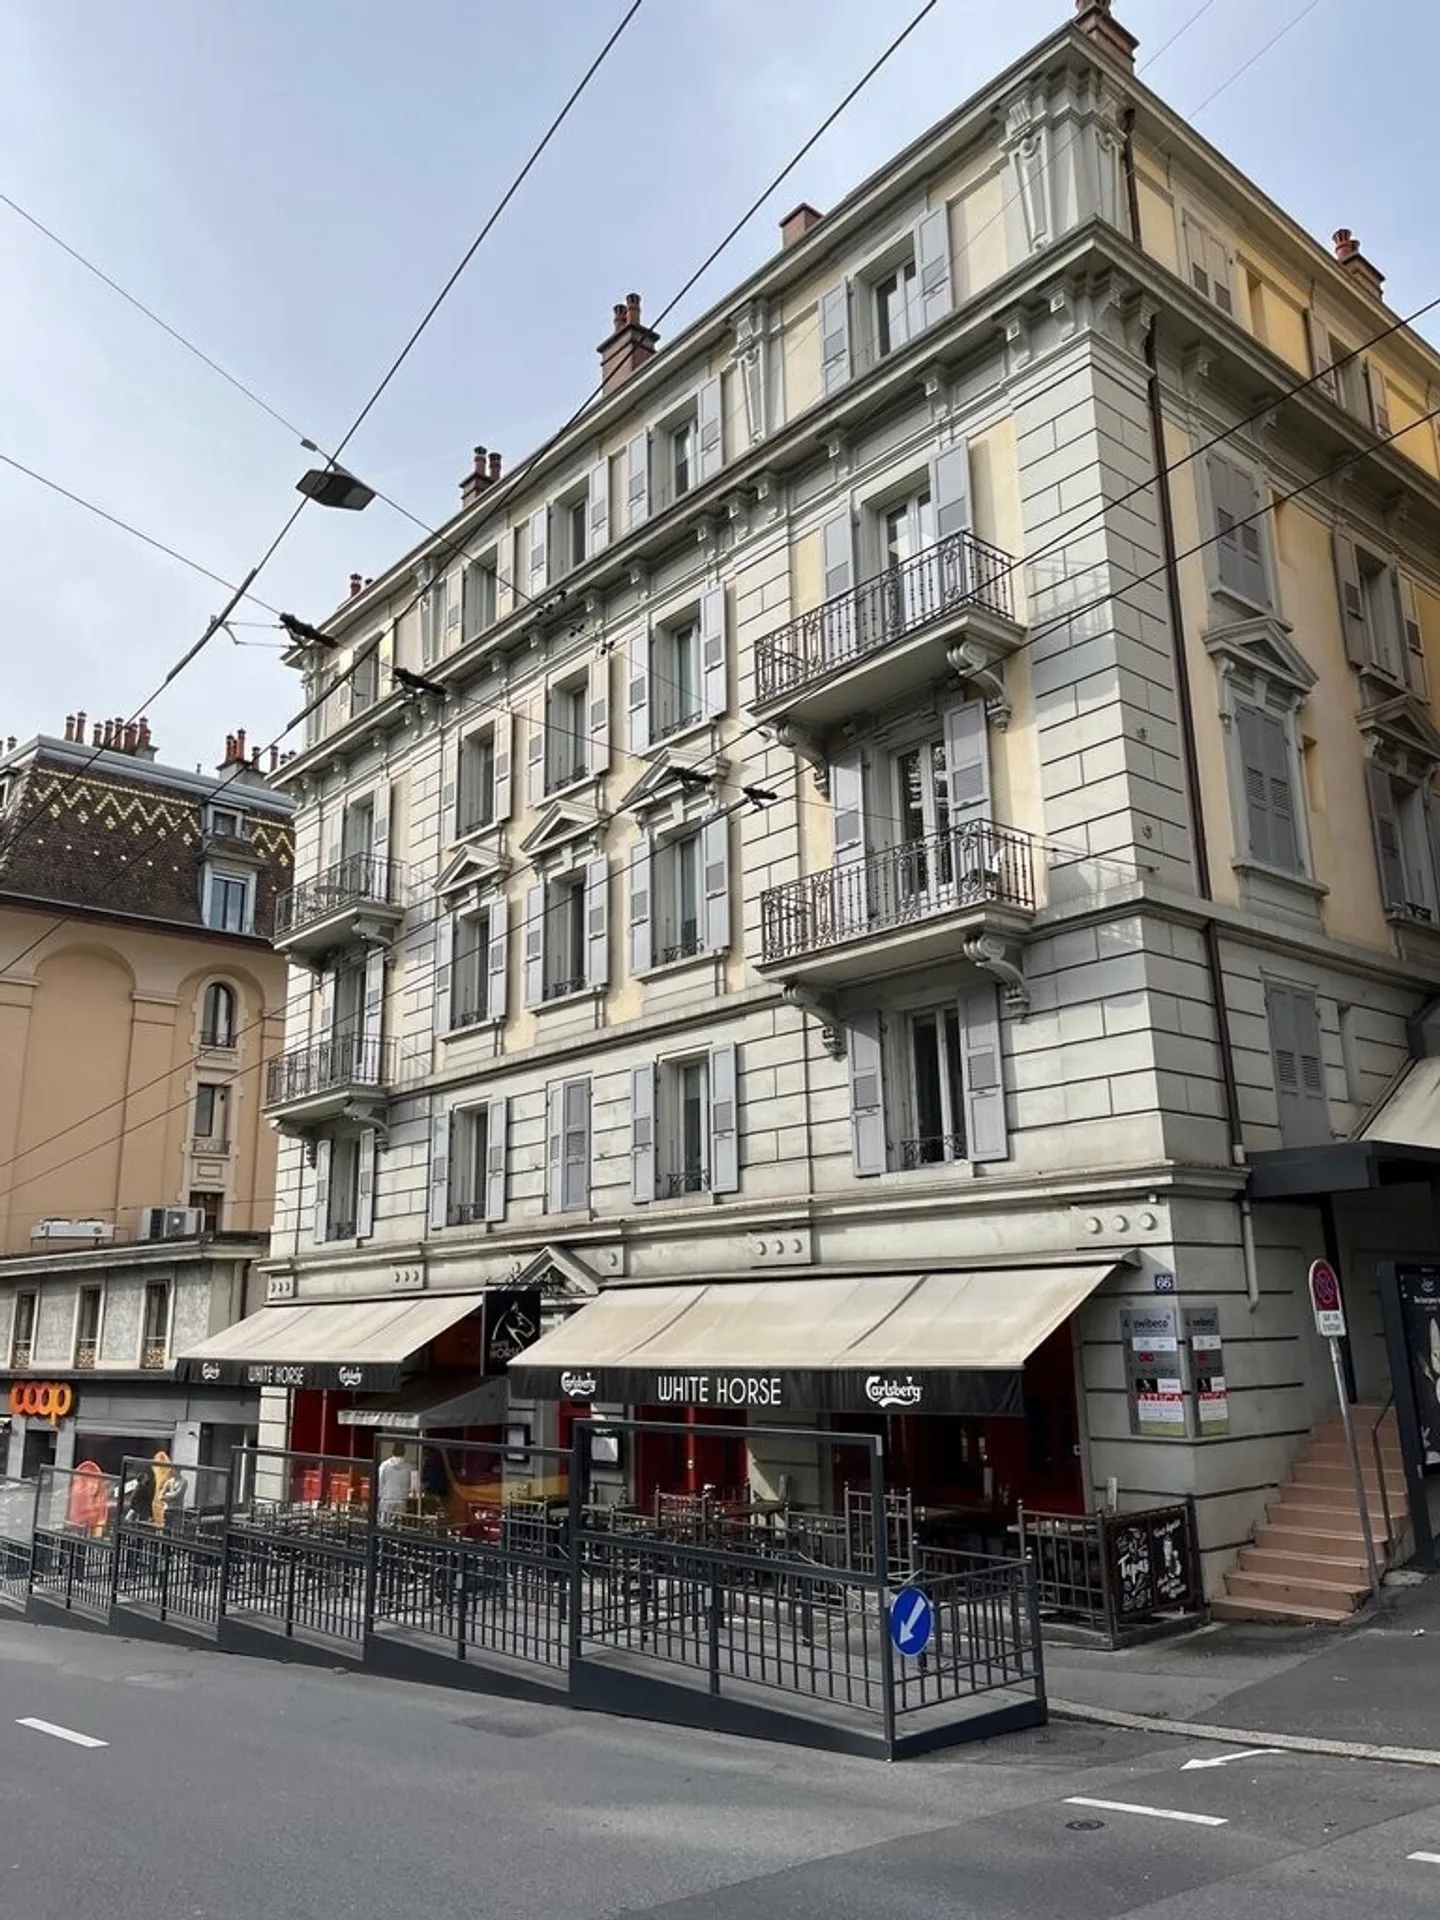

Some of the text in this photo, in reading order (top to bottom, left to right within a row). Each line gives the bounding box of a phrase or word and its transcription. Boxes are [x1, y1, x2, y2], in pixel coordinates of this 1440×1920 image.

[248, 1365, 304, 1385] WHITE HORSE
[10, 1382, 72, 1427] coop
[658, 1376, 782, 1405] WHITE HORSE
[866, 1375, 923, 1407] Carlsberg
